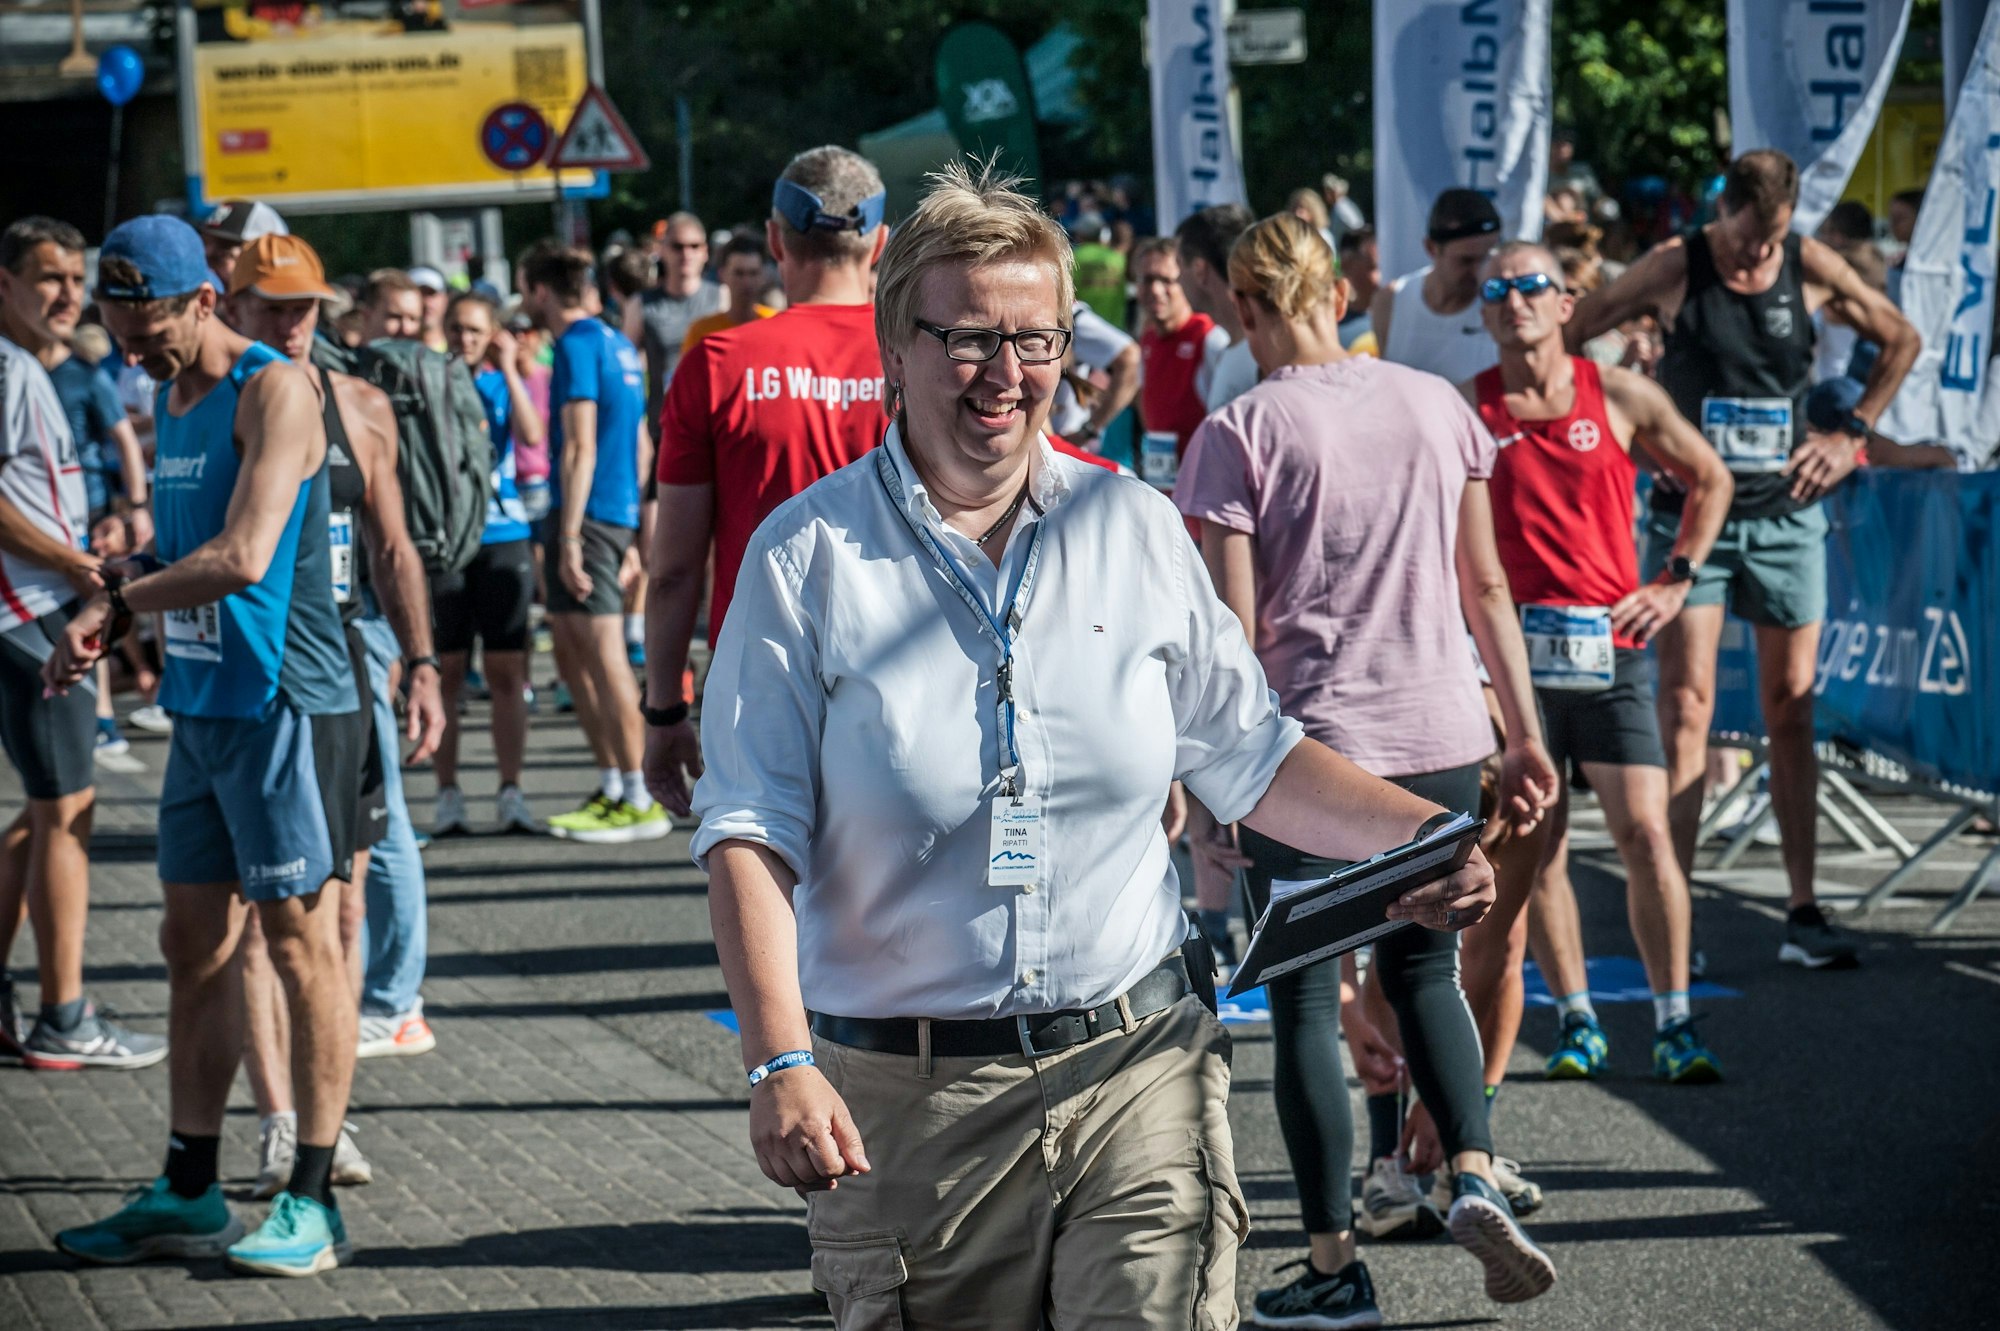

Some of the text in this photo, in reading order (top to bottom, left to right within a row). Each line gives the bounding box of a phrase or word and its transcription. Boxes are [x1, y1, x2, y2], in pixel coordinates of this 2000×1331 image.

[785, 366, 885, 411] Wupper
[1549, 639, 1583, 658] 107
[1004, 828, 1028, 837] TIINA
[1002, 839, 1028, 847] RIPATTI
